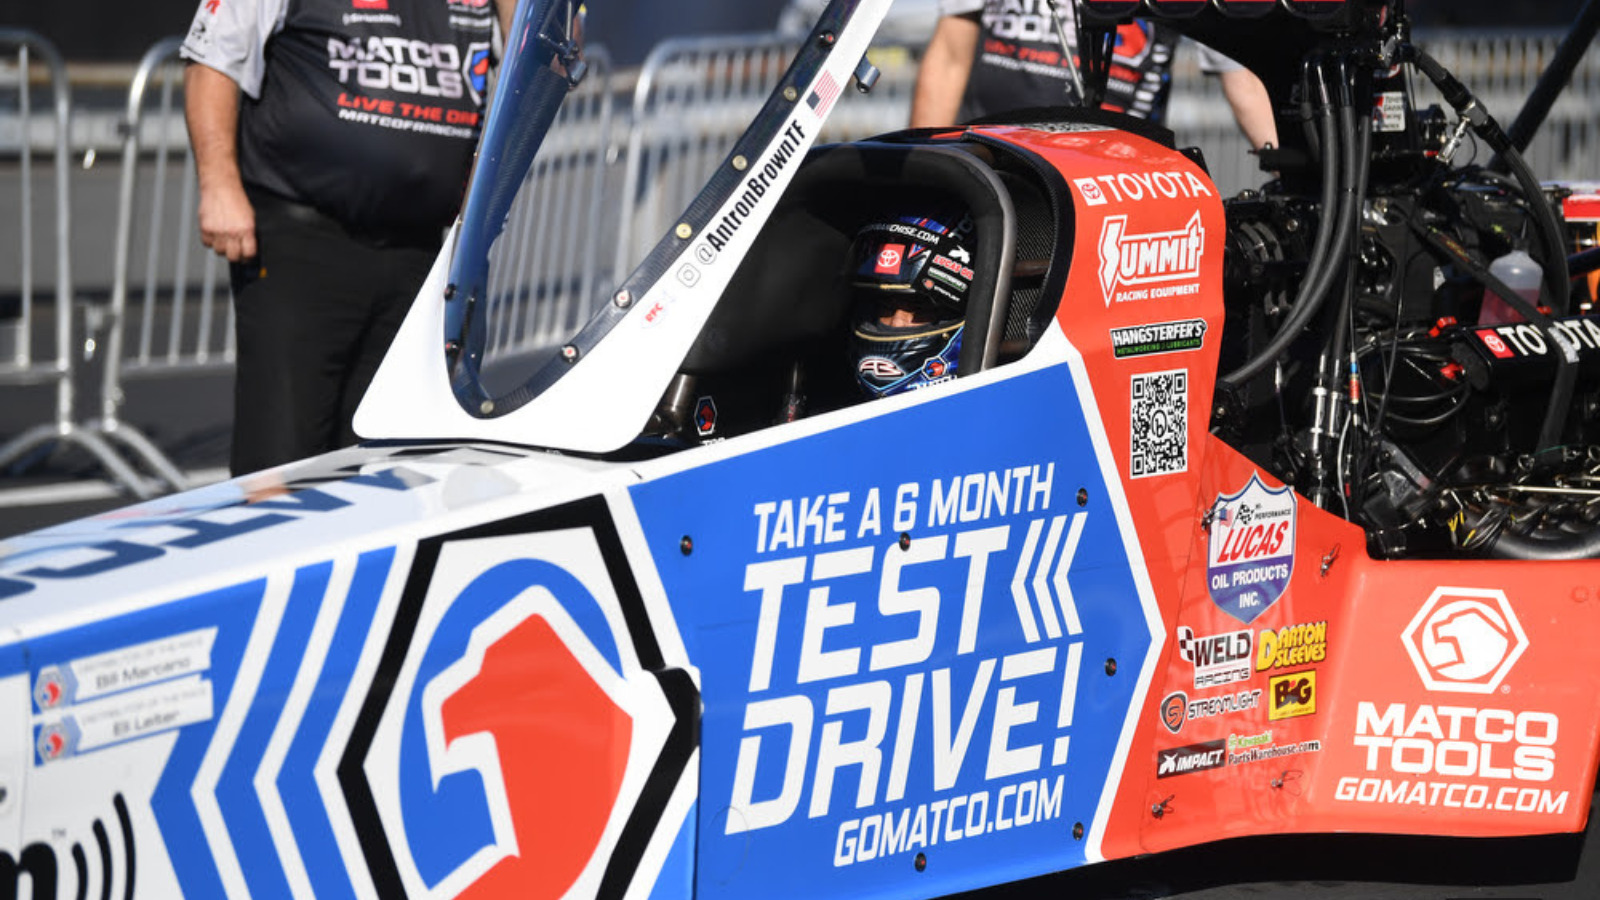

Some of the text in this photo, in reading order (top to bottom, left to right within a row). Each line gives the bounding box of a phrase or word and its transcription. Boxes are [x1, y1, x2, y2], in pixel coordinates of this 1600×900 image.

[327, 36, 459, 70] MATCO
[328, 60, 463, 99] TOOLS
[337, 92, 395, 115] LIVE
[399, 102, 443, 122] THE
[1097, 171, 1212, 202] TOYOTA
[1116, 284, 1200, 302] RACING EQUIPMENT
[1112, 322, 1203, 347] HANGSTERFER'S
[753, 462, 1055, 553] TAKE A 6 MONTH
[1216, 520, 1289, 563] LUCAS
[1212, 563, 1289, 590] OIL PRODUCTS
[743, 524, 1011, 693] TEST
[1239, 593, 1260, 608] INC.
[1194, 632, 1251, 667] WELD
[1256, 621, 1327, 672] DARTON
[1274, 642, 1326, 668] SLEEVES
[1196, 668, 1250, 686] RACING
[1188, 690, 1261, 720] STREAMLIGHT
[724, 641, 1084, 835] DRIVE!
[1355, 701, 1559, 746] MATCO
[1176, 749, 1225, 771] IMPACT
[1228, 741, 1320, 764] PartsWarehouse.com
[1354, 735, 1556, 781] TOOLS
[1334, 776, 1569, 814] GOMATCO.COM
[833, 774, 1065, 867] GOMATCO.COM
